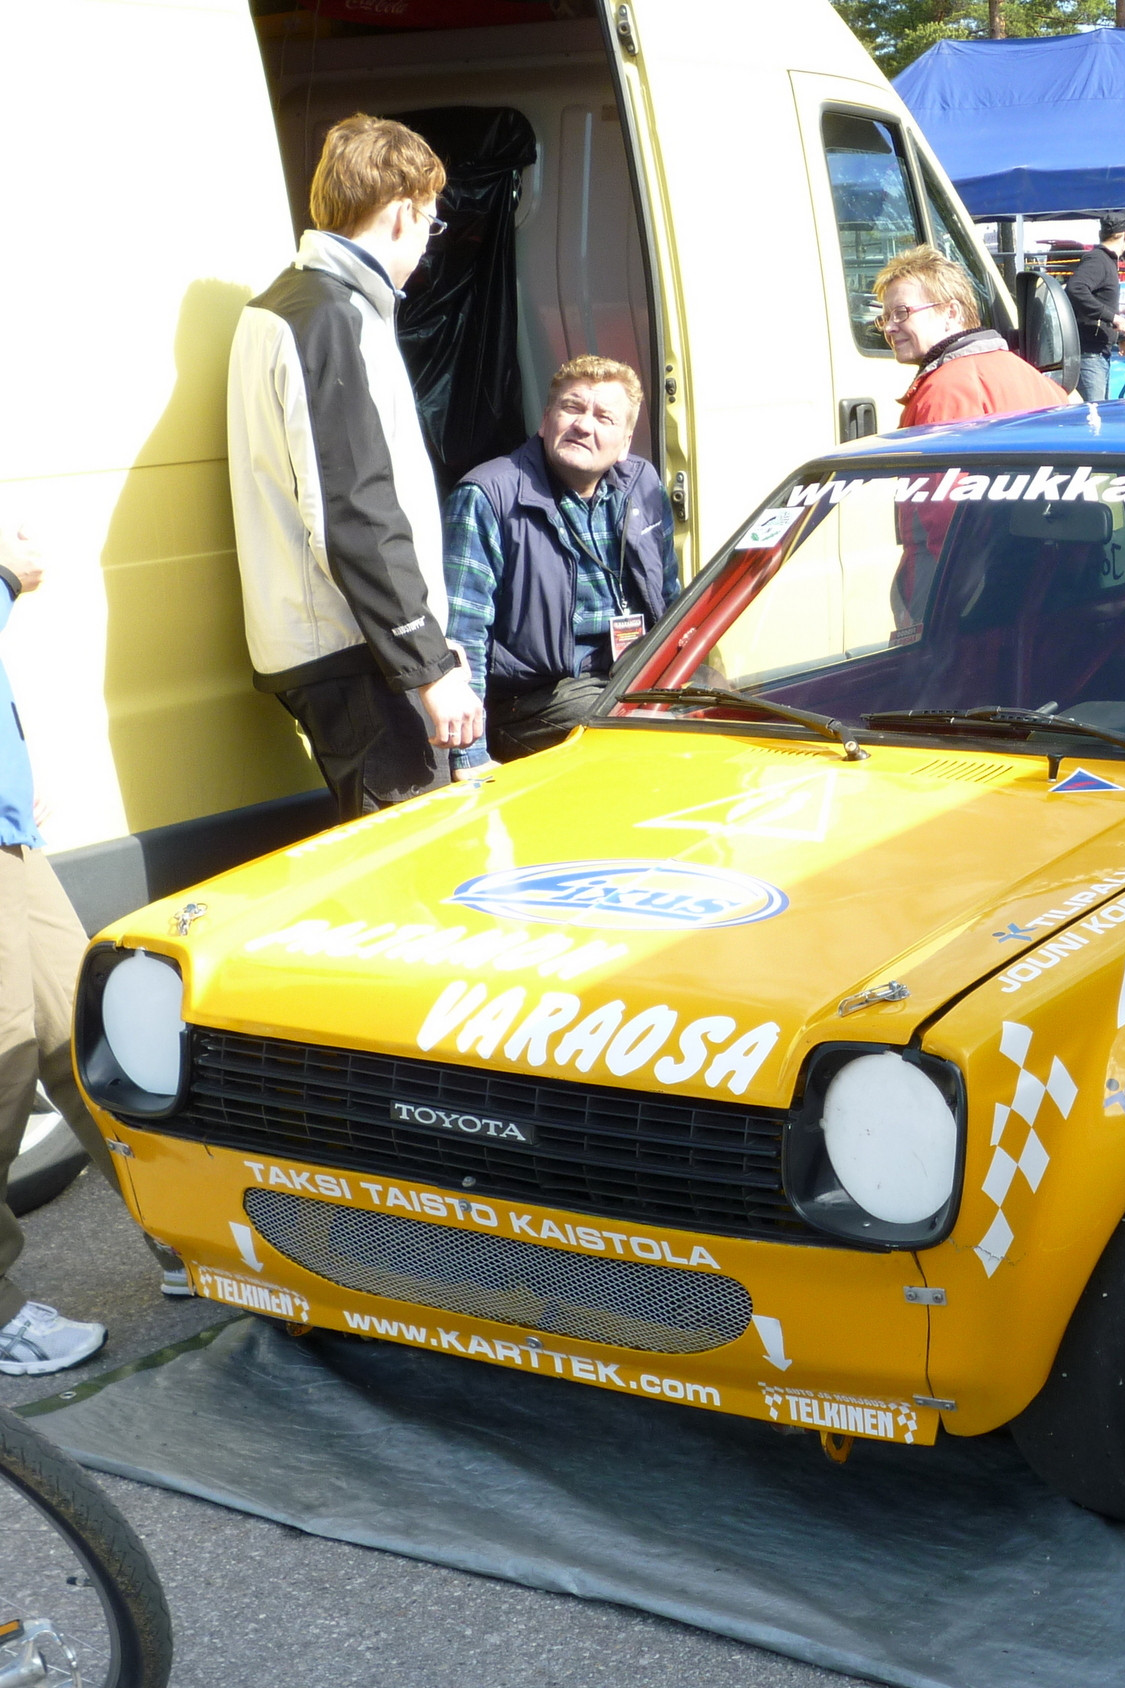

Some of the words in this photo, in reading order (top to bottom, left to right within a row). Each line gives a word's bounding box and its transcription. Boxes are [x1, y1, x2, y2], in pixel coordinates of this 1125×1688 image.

[998, 931, 1090, 993] JOUNI
[416, 979, 780, 1094] VARAOSA
[394, 1103, 527, 1141] TOYOTA
[243, 1160, 353, 1200] TAKSI
[359, 1181, 498, 1227] TAISTO
[509, 1211, 721, 1270] KAISTOLA
[342, 1311, 721, 1407] www.KARTTEK.com
[785, 1395, 894, 1439] TELKINEN
